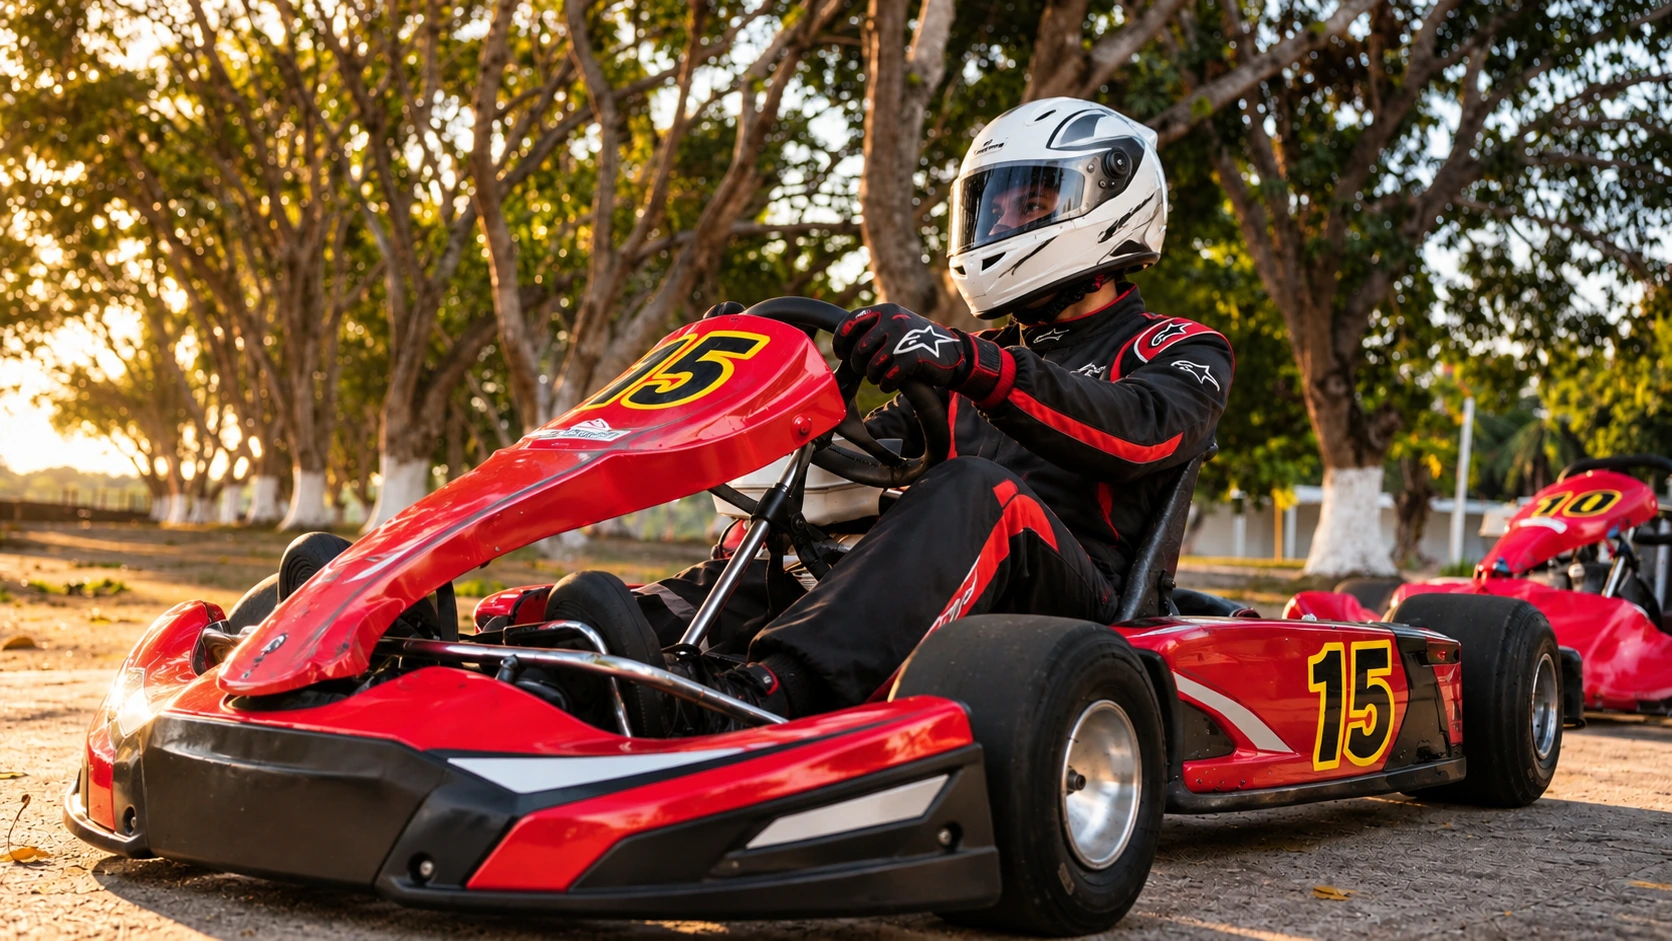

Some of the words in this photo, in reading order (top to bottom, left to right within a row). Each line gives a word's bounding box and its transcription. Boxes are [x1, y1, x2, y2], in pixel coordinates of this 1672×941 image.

[578, 331, 770, 410] 15
[1531, 489, 1622, 518] 10
[1307, 639, 1395, 772] 15
